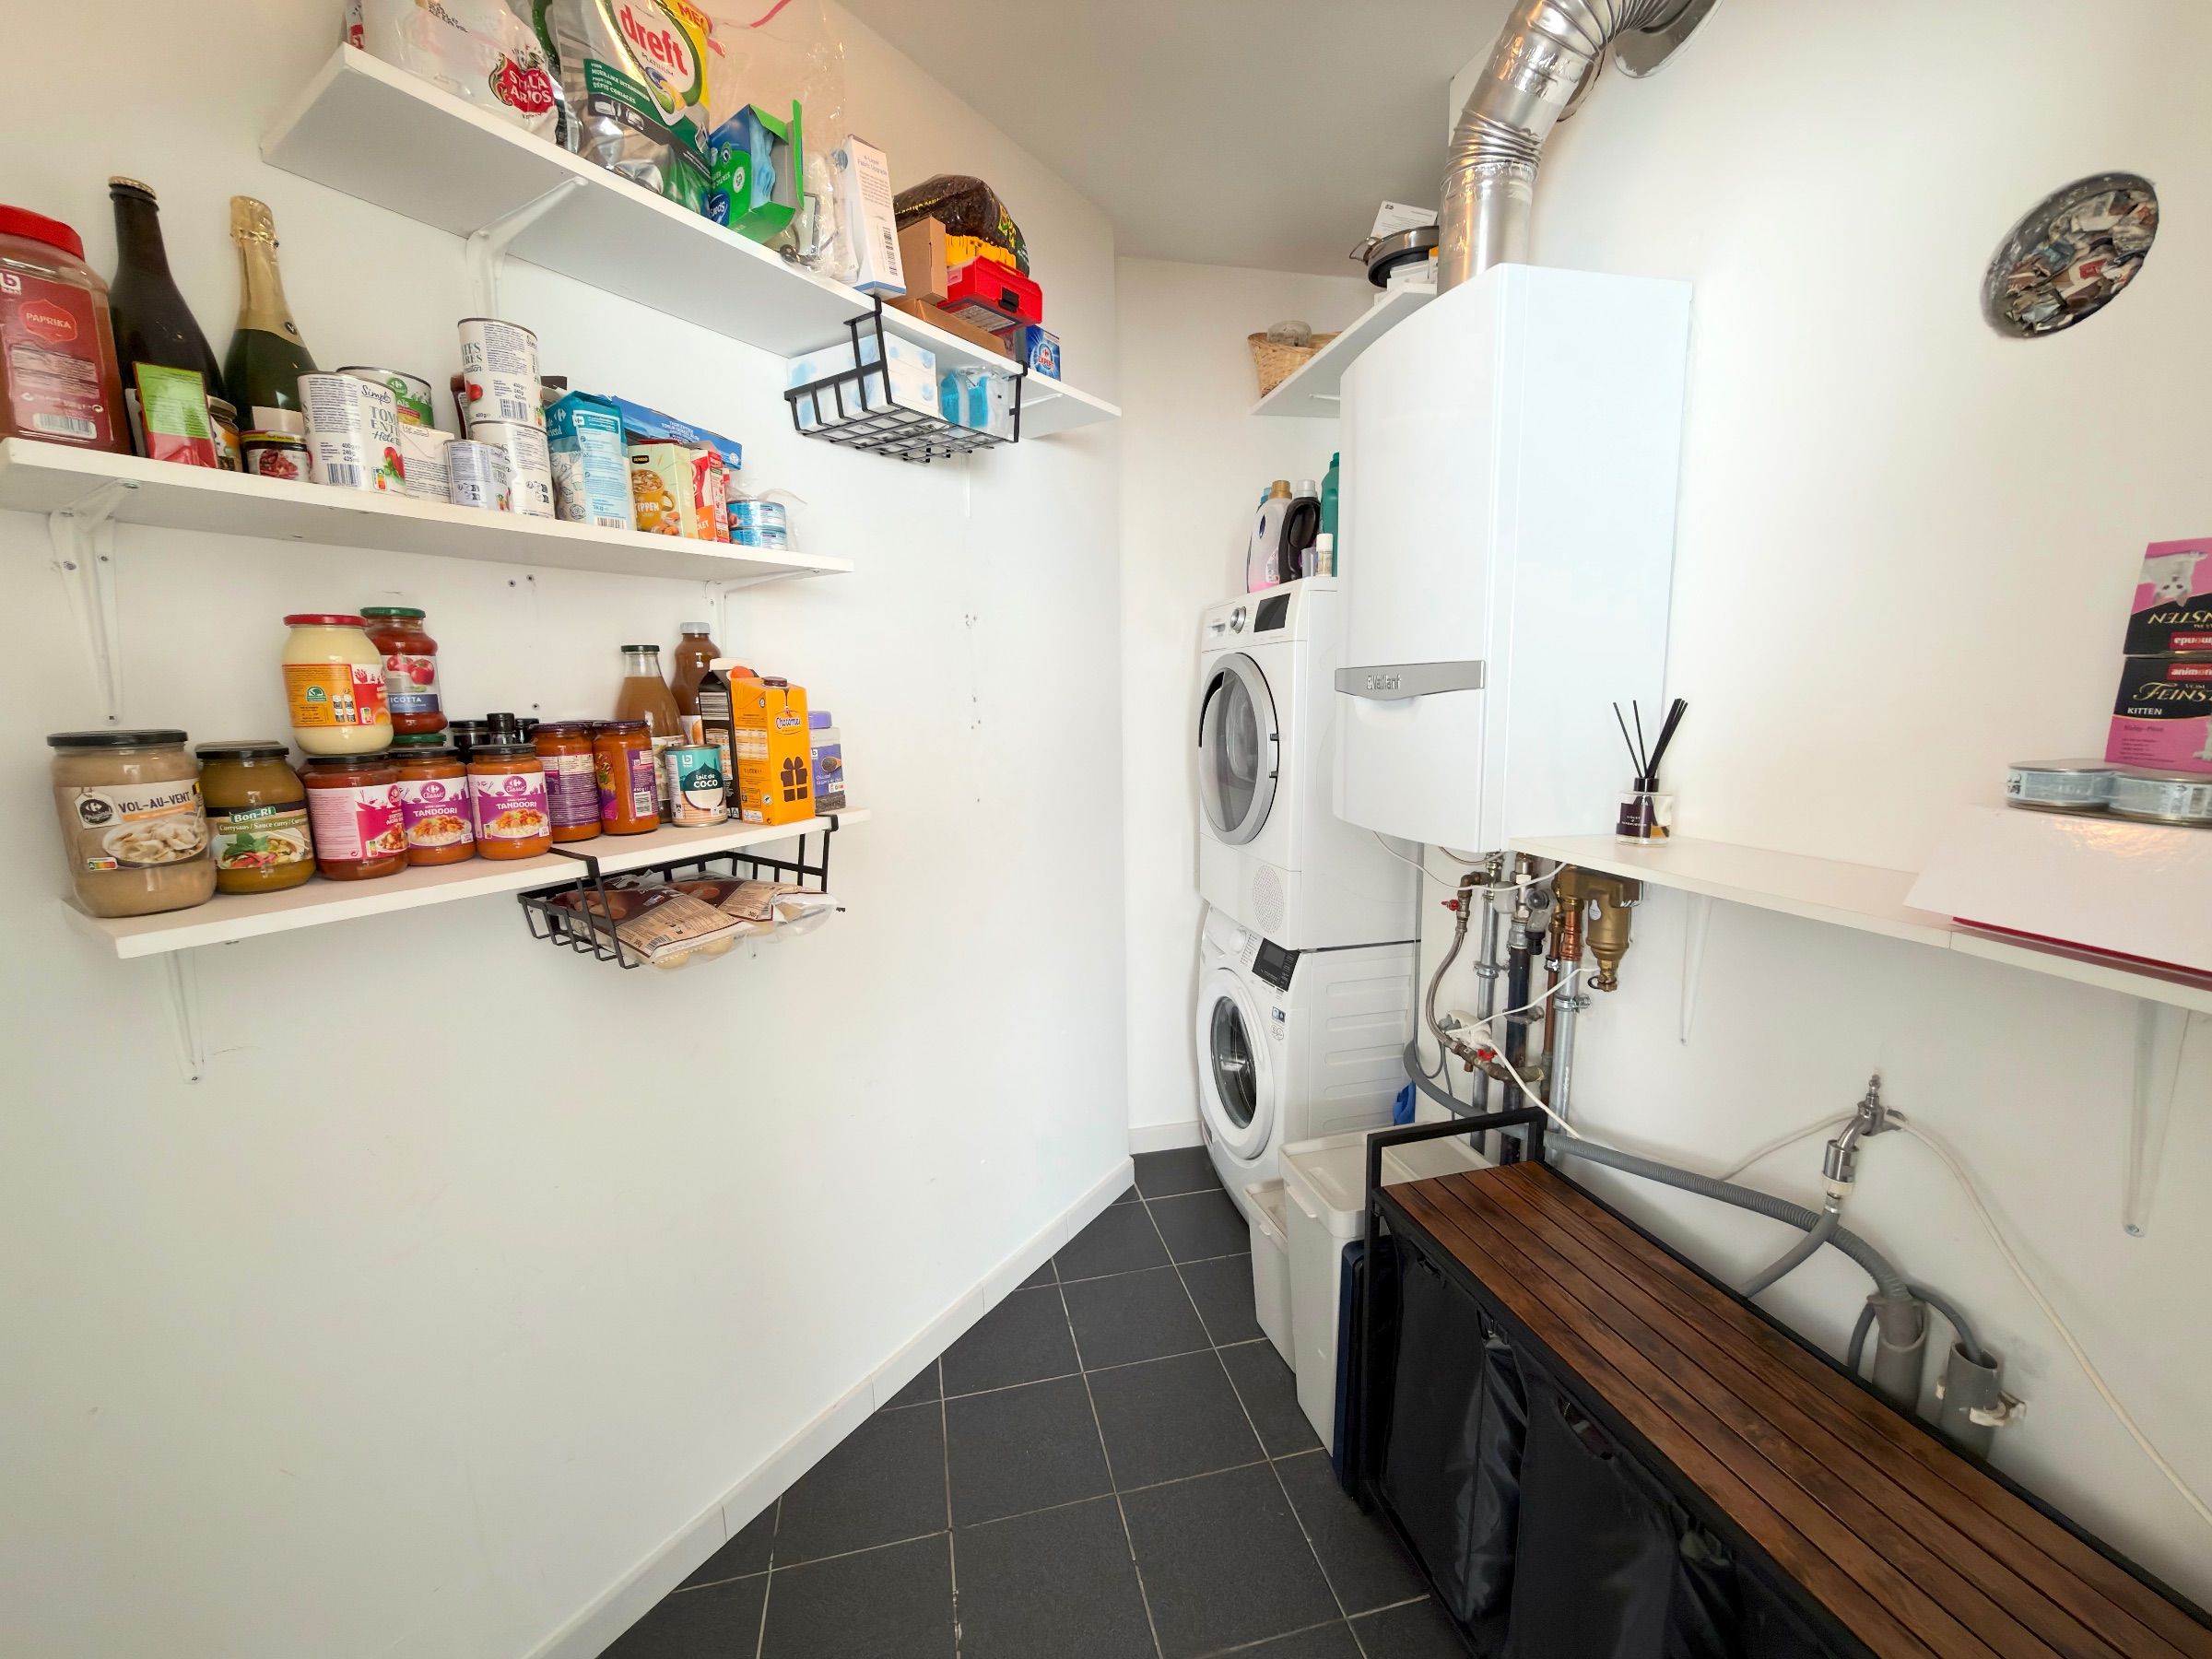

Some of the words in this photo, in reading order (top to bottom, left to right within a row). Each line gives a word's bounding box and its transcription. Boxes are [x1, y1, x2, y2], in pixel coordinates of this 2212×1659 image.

[619, 4, 688, 76] dreft
[26, 312, 72, 329] PAPRIKA
[1373, 675, 1400, 690] Vaillant
[2127, 707, 2163, 716] KITTEN
[118, 791, 191, 814] VOL-AU-VENT
[495, 801, 537, 810] TANDOORI
[412, 806, 459, 818] TANDOORI
[253, 821, 273, 830] Sauce
